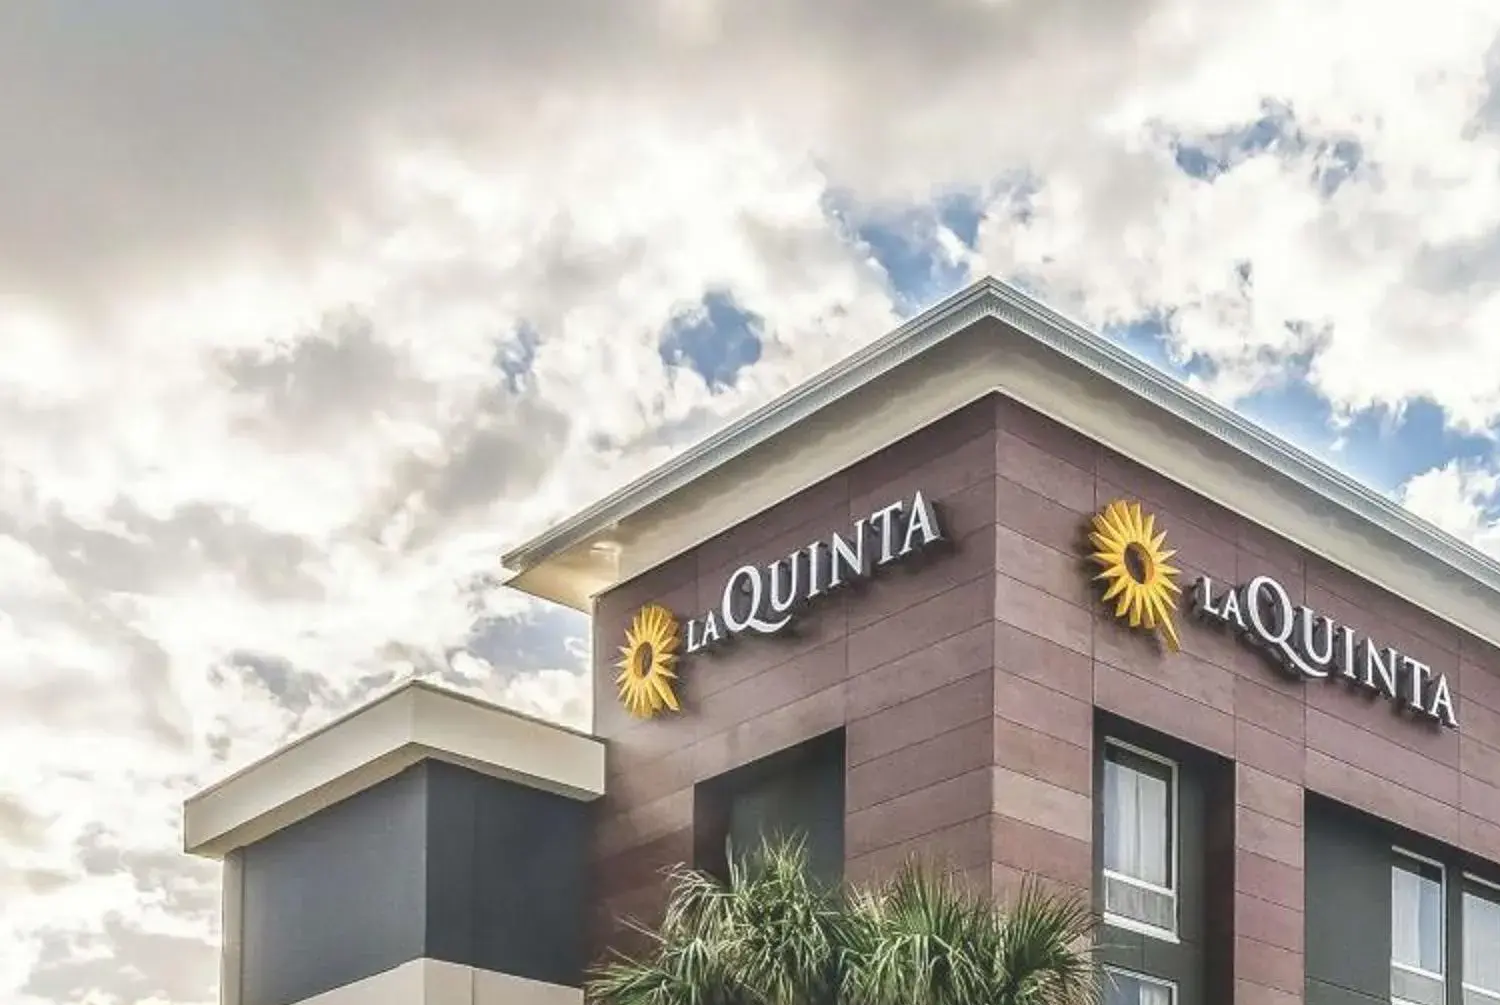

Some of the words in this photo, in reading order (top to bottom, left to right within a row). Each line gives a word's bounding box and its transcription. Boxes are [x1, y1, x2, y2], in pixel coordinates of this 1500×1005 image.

[686, 610, 721, 653] LA
[722, 490, 942, 633] QUINTA
[1201, 576, 1247, 629] LA
[1247, 575, 1460, 728] QUINTA
